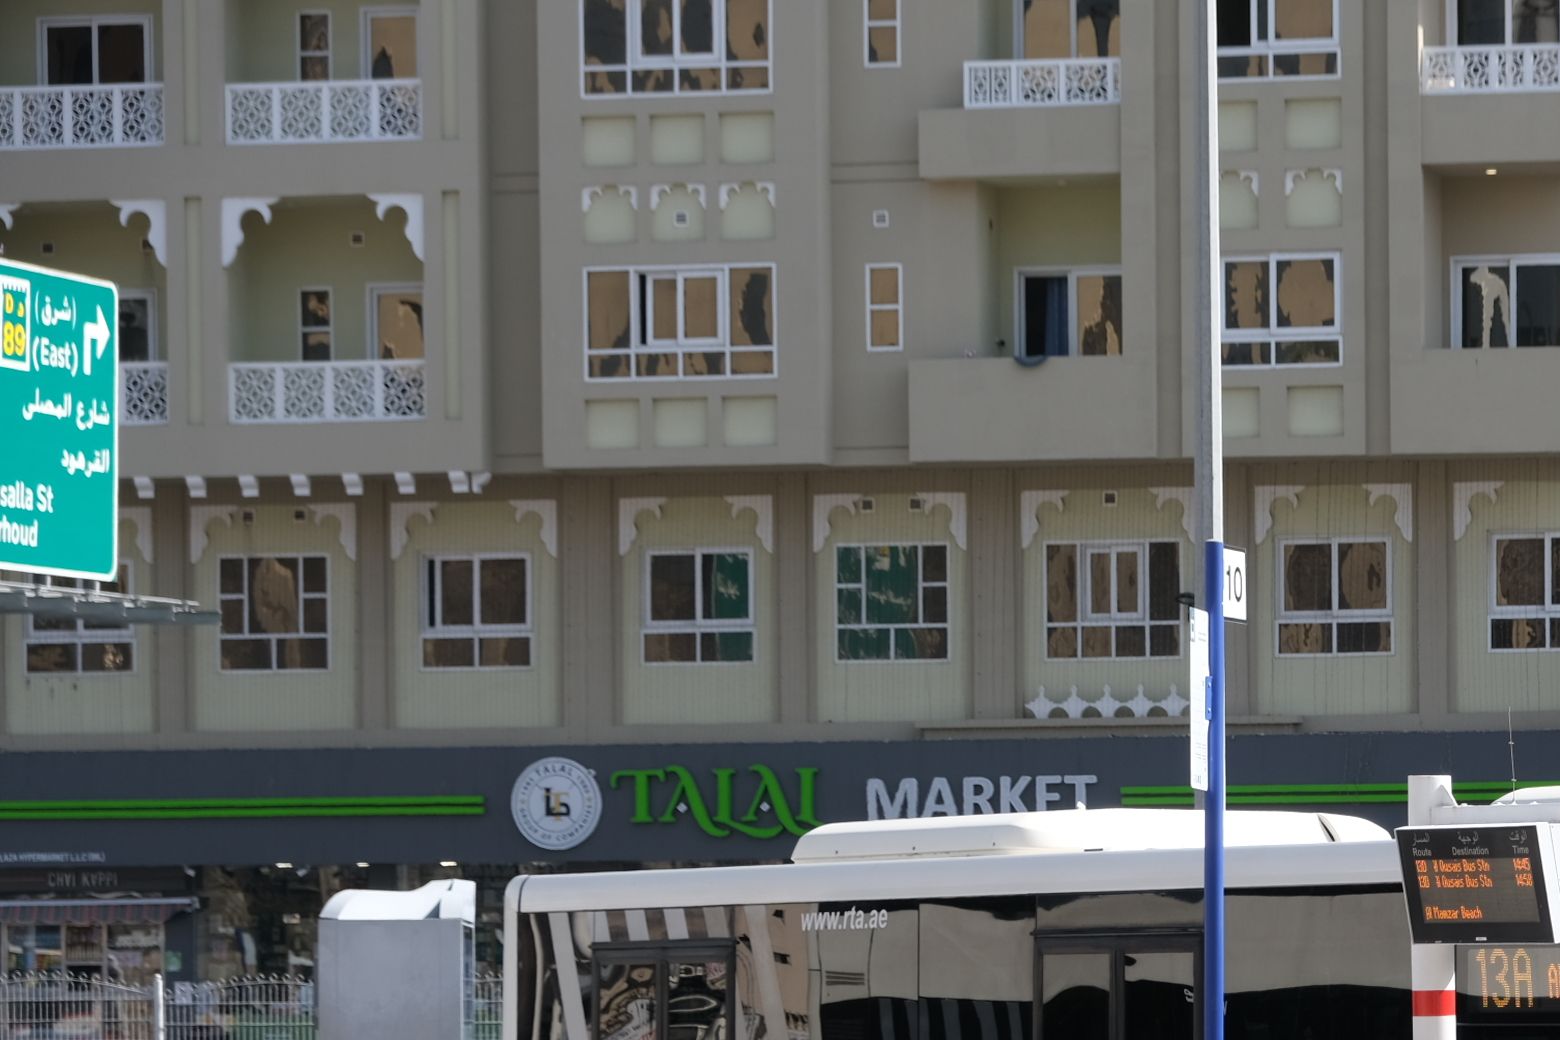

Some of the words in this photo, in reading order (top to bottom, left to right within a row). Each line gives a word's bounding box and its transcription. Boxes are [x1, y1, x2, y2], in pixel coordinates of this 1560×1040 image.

[5, 292, 14, 314] D
[3, 321, 26, 357] 89
[32, 335, 78, 378] (East)
[76, 397, 110, 431] شارع
[36, 483, 54, 514] St
[1226, 565, 1243, 602] 10
[610, 764, 824, 839] TALAL
[1412, 847, 1432, 857] Route
[1451, 846, 1490, 856] Destination
[1512, 845, 1530, 854] Time
[801, 905, 888, 931] www.rta.ae
[1476, 948, 1533, 1008] 13A
